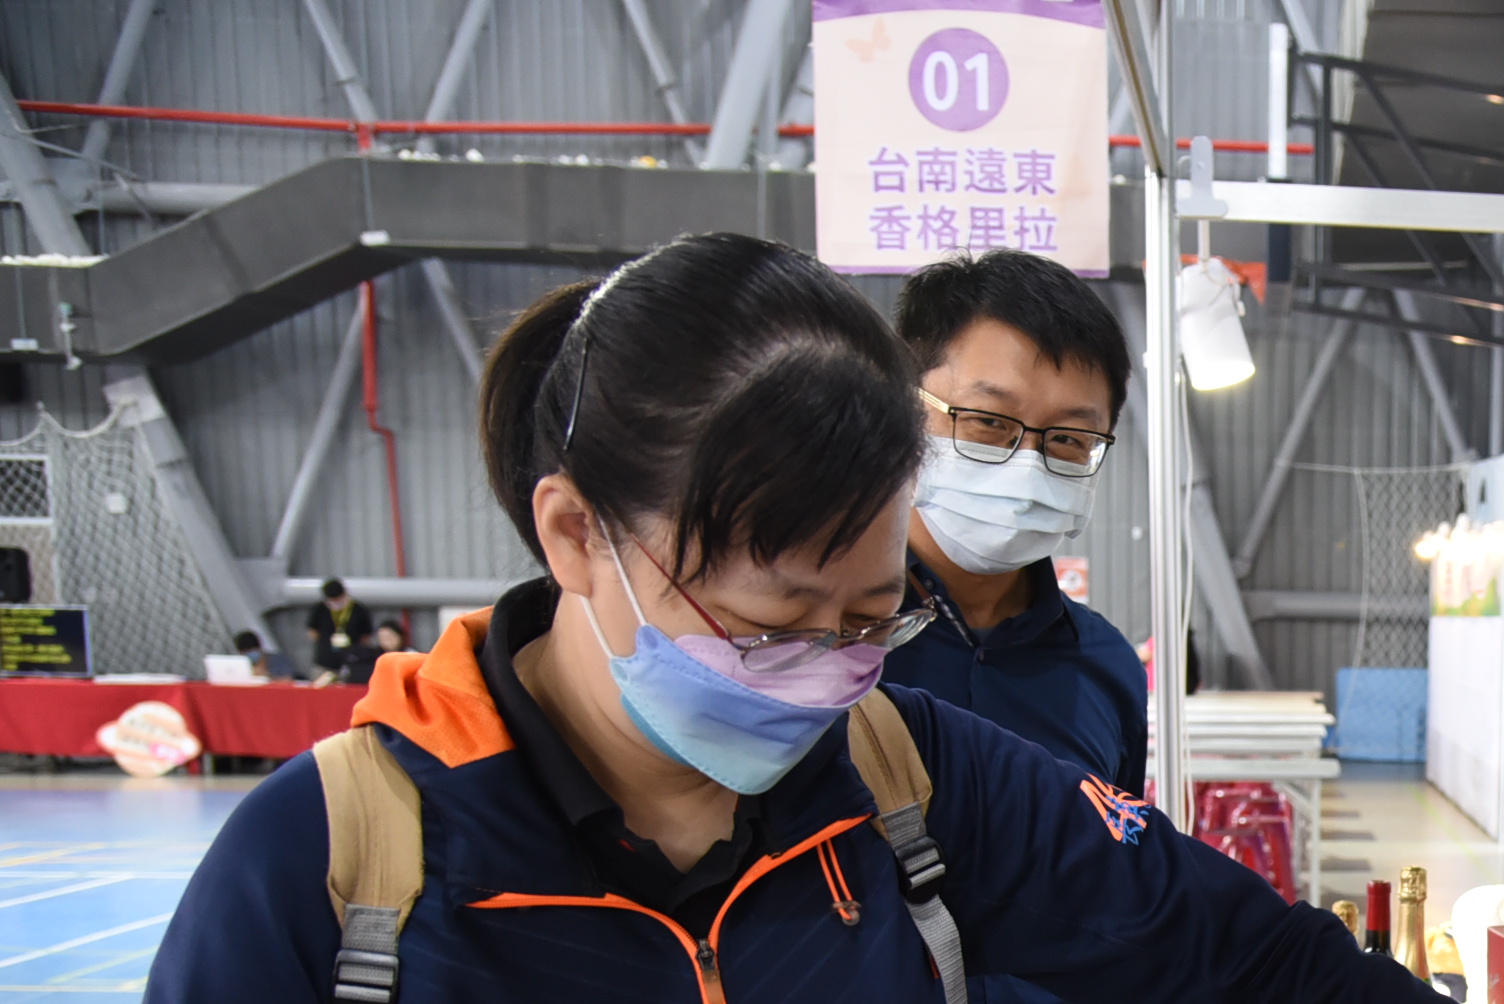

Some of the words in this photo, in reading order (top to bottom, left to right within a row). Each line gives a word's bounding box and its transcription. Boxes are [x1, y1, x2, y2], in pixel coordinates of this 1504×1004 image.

[923, 51, 990, 112] 01
[868, 147, 1057, 196] 台南遠東
[869, 204, 1058, 252] 香格里拉
